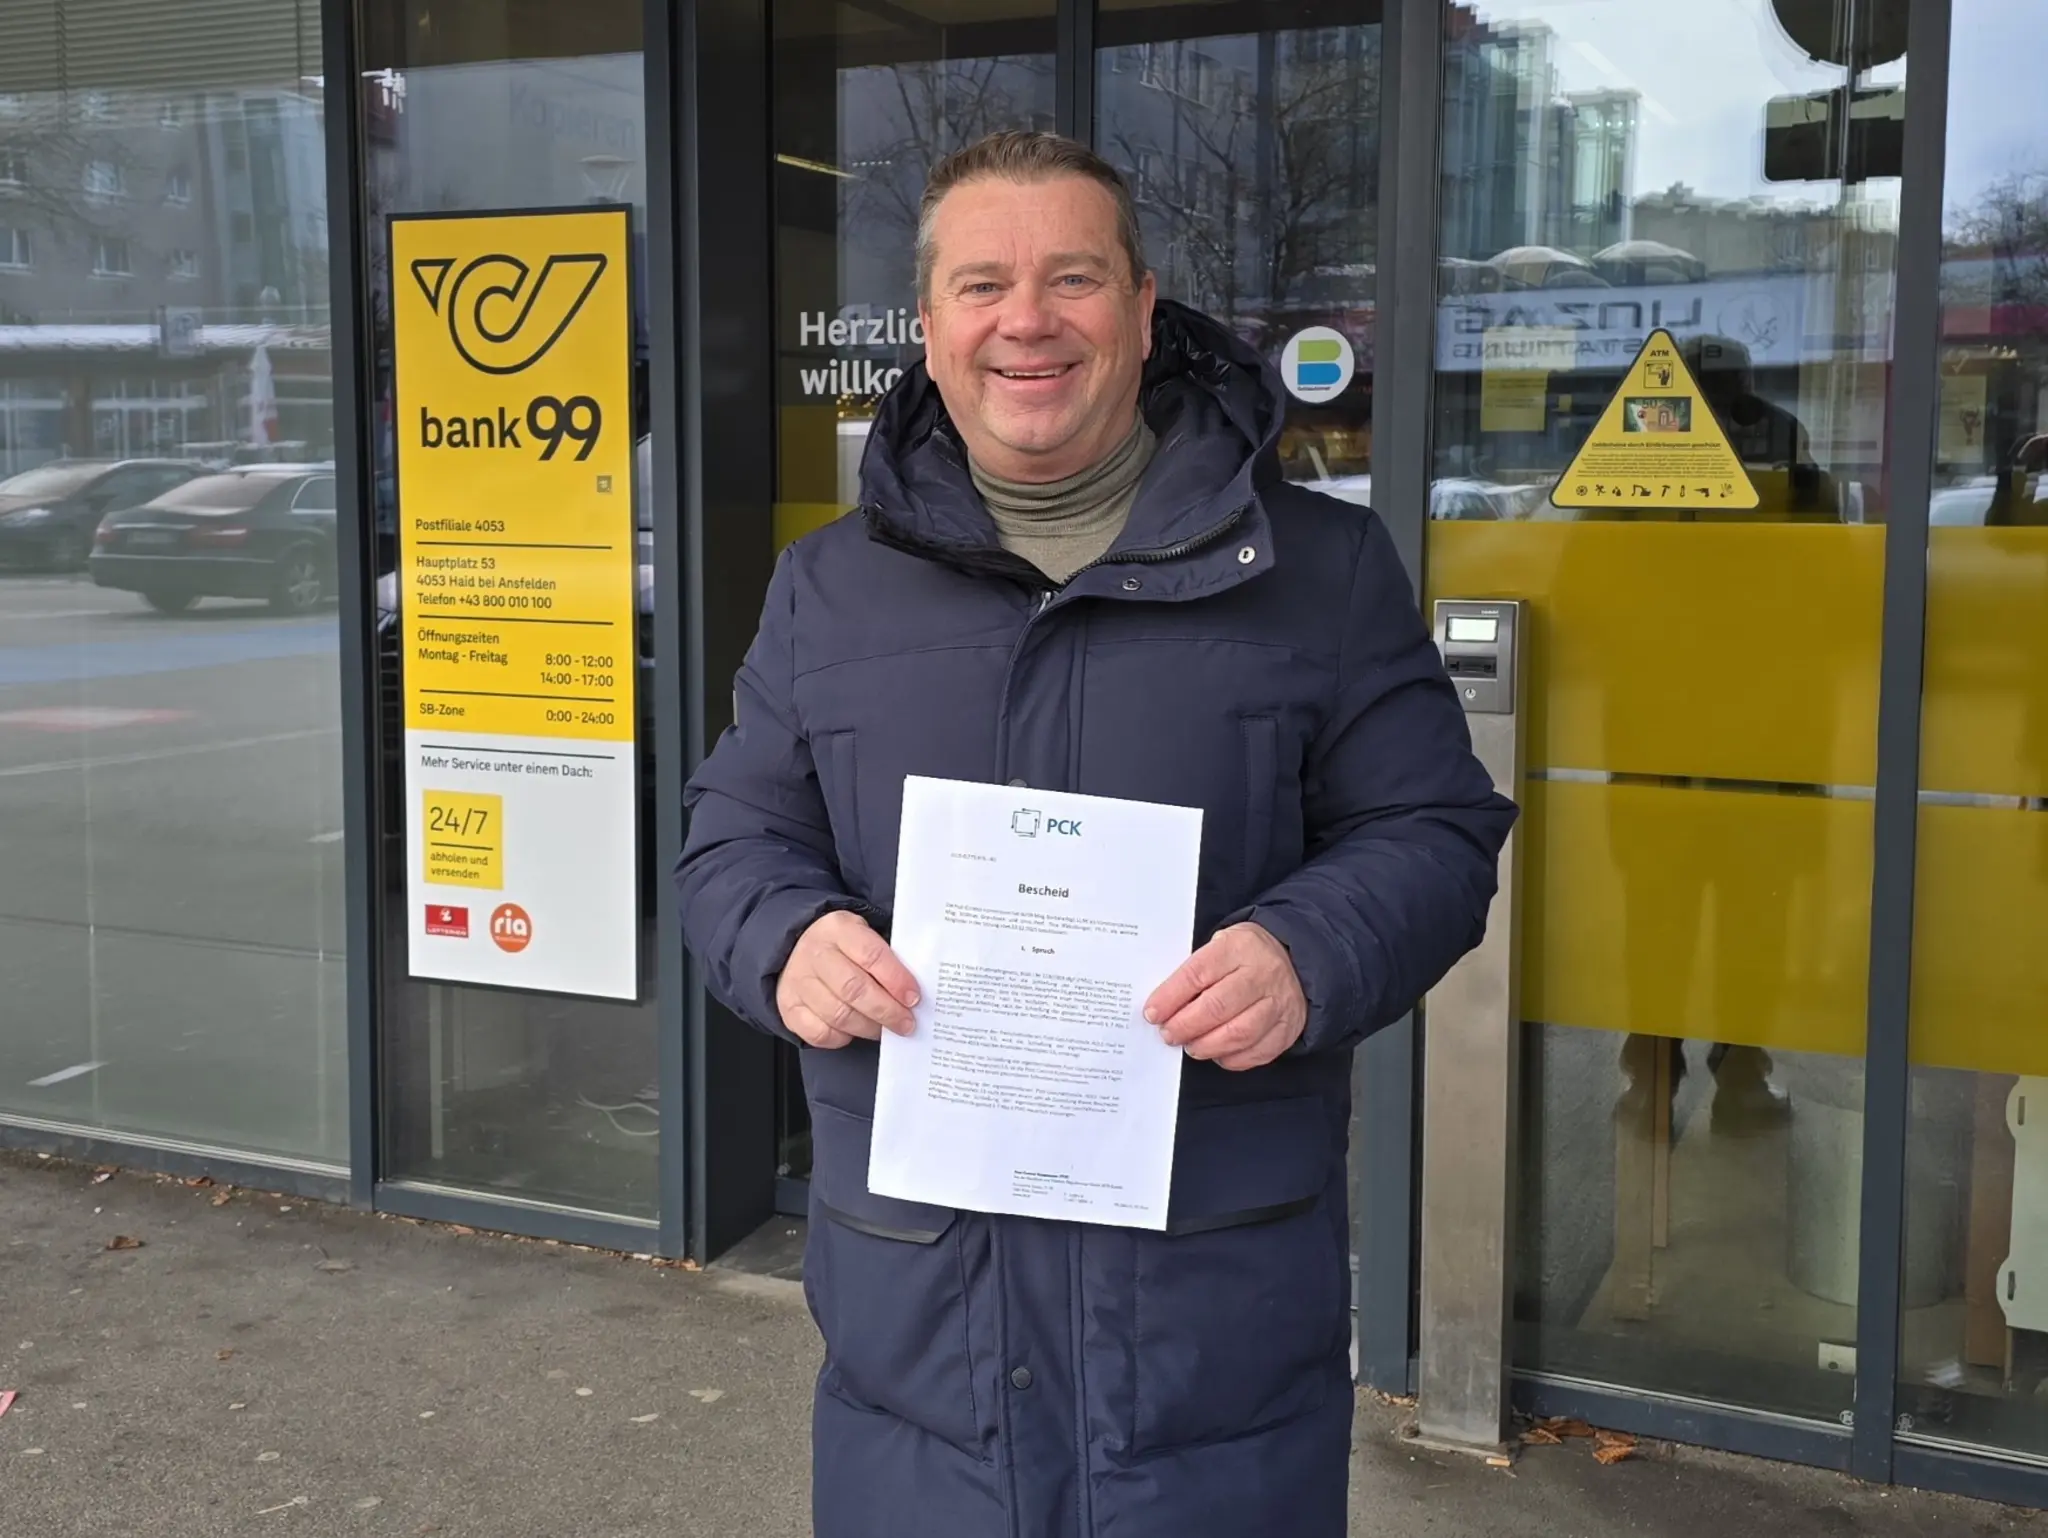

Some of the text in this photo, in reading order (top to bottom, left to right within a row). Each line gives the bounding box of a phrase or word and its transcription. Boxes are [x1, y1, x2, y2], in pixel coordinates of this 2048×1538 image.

[800, 308, 926, 346] Herzlic
[1649, 349, 1670, 357] ATM
[800, 358, 904, 395] willko
[415, 518, 505, 533] Postfiliale 4053
[416, 556, 496, 570] Hauptplatz 53
[416, 574, 557, 590] 4053 Haid bei Ansfelden
[417, 593, 552, 609] Telefon +43 800 010 100
[418, 627, 500, 645] Öffnungszeiten
[418, 648, 460, 664] Montag
[469, 650, 508, 666] Freitag
[545, 653, 572, 667] 8:00
[581, 655, 614, 668] 12:00
[540, 672, 572, 686] 14:00
[581, 674, 614, 687] 17:00
[419, 703, 465, 716] SB-Zone
[546, 709, 572, 723] 0:00
[581, 711, 615, 725] 24:00
[421, 755, 593, 778] Mehr Service unter einem Dach:
[430, 806, 488, 835] 24/7
[1047, 818, 1083, 837] PCK
[430, 852, 489, 866] abholen und
[431, 867, 480, 880] versenden
[1018, 883, 1070, 898] Bescheid
[494, 909, 528, 936] ria
[1032, 946, 1055, 955] Spruch
